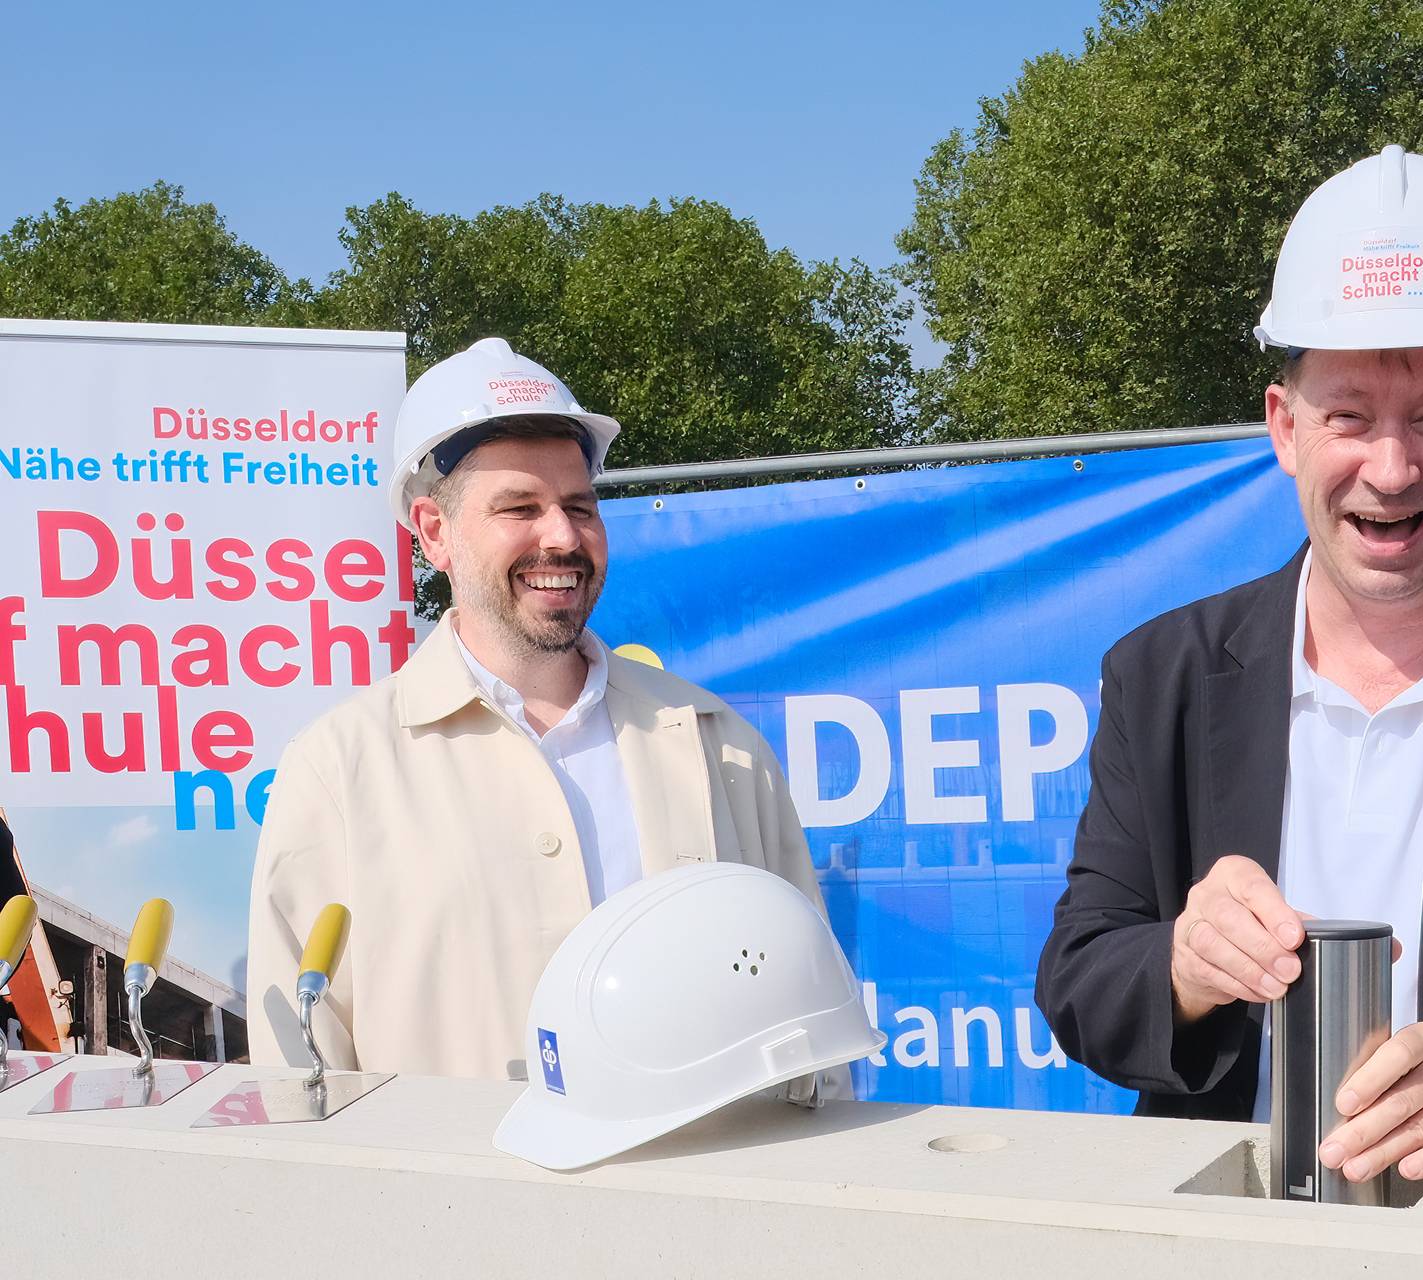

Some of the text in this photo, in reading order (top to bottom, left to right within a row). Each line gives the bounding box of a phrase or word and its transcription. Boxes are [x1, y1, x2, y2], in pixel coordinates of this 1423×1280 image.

[1342, 282, 1402, 300] Schule
[1363, 267, 1419, 284] macht
[153, 406, 379, 444] Düsseldorf
[0, 447, 378, 487] Nähe trifft Freiheit
[57, 600, 416, 688] macht
